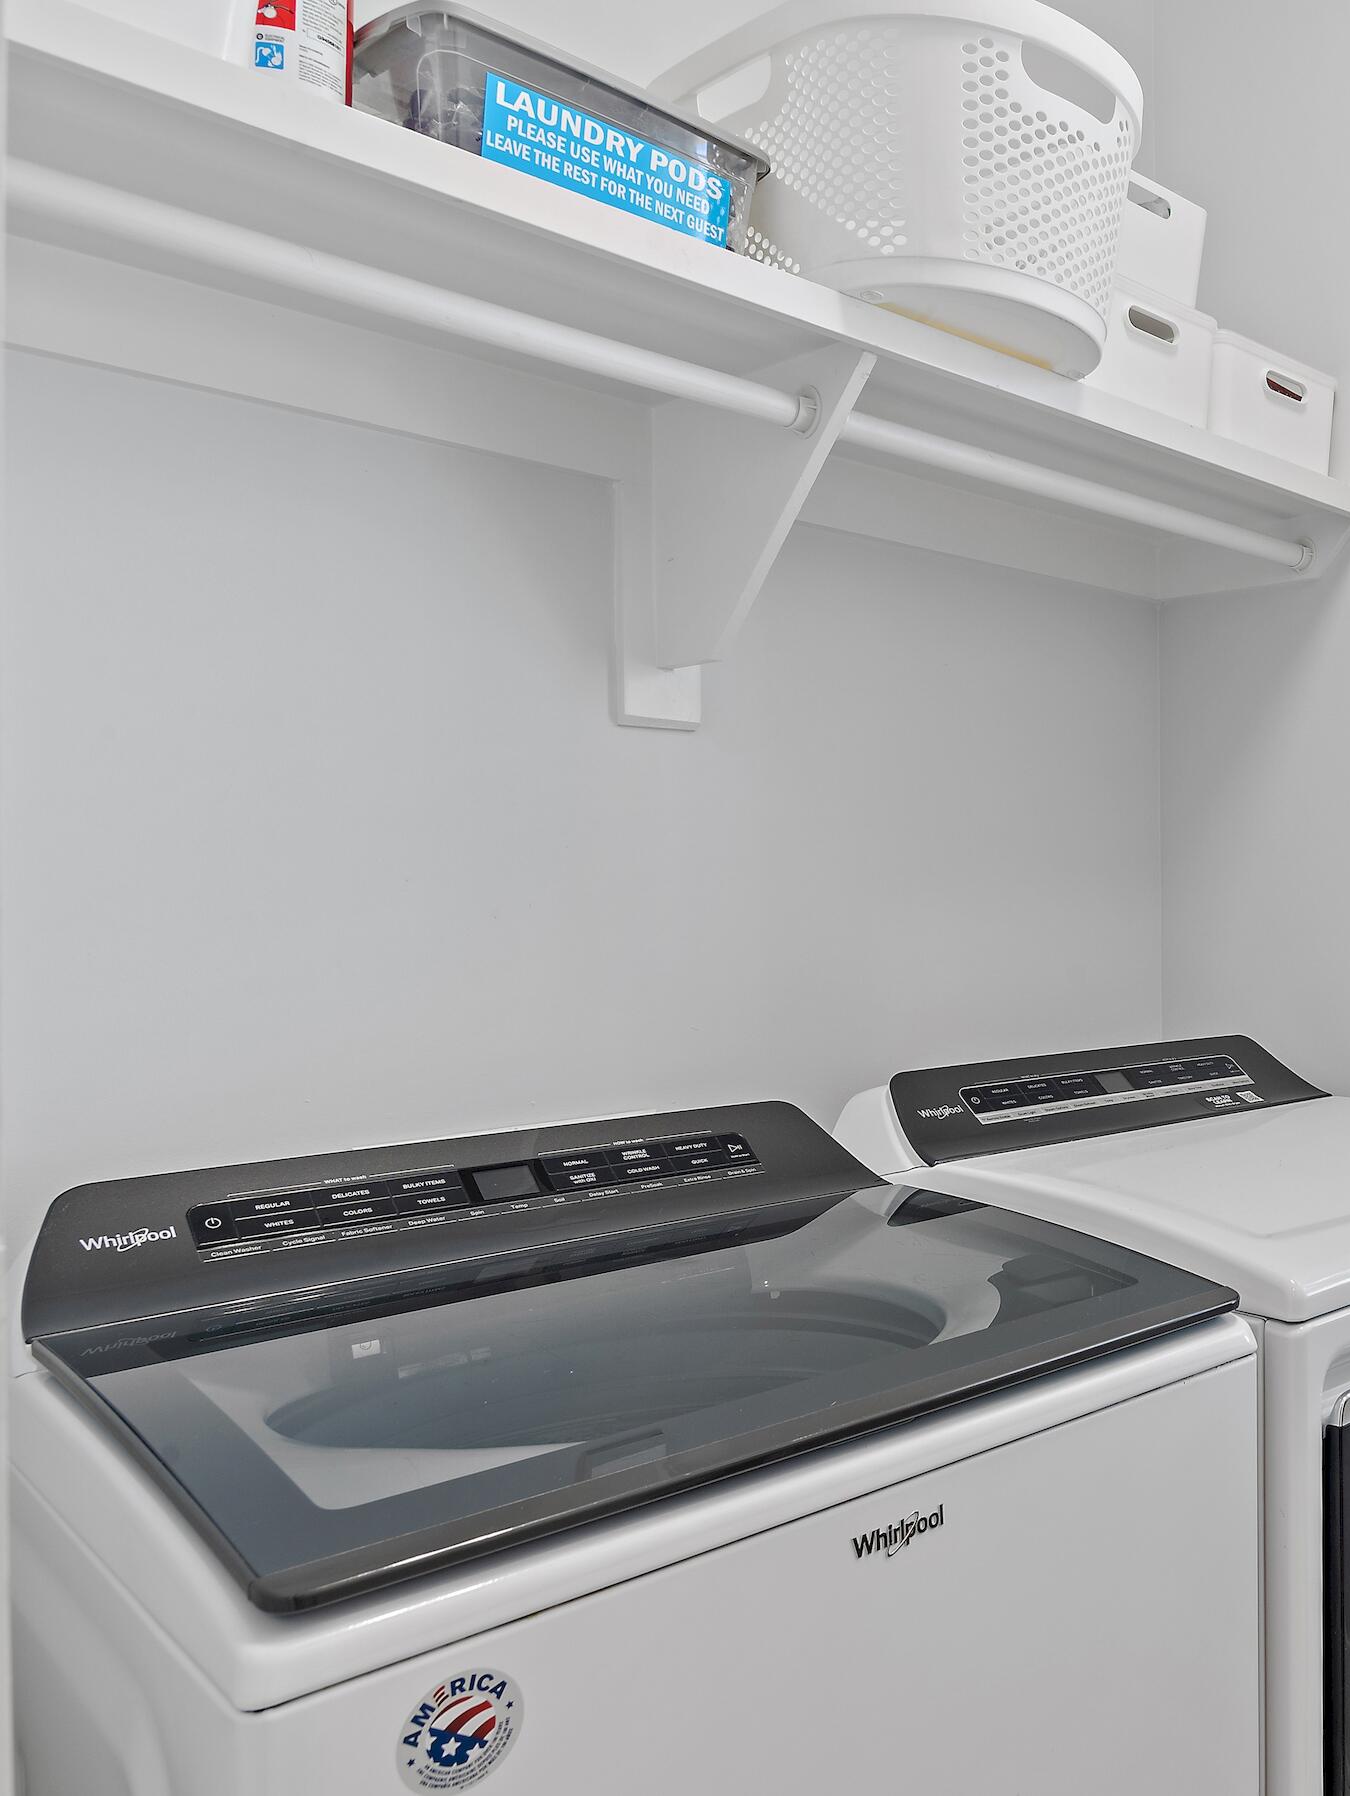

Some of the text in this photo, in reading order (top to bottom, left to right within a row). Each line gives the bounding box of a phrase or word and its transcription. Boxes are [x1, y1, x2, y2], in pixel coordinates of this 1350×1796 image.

[495, 80, 723, 200] LAUNDRY PODS
[507, 114, 711, 216] PLEASE USE WHAT YOU NEED
[486, 130, 724, 242] LEAVE THE REST FOR THE NEXT GUEST
[917, 1105, 965, 1120] Whirlpool
[621, 1148, 647, 1156] WRINKLE
[622, 1153, 650, 1161] CONTROL
[563, 1159, 589, 1167] NORMAL
[323, 1177, 343, 1185] WHAT
[569, 1172, 596, 1181] SANITIZE
[402, 1178, 446, 1190] BULKY ITEMS
[331, 1189, 370, 1200] DELICATES
[255, 1201, 291, 1211] REGULAR
[417, 1196, 446, 1205] TOWELS
[342, 1207, 373, 1217] COLORS
[470, 1209, 485, 1217] Spin
[264, 1219, 295, 1229] WHITES
[408, 1219, 427, 1227] Deep
[341, 1224, 393, 1237] Fabric Softener
[79, 1226, 177, 1252] Whirlpool
[282, 1234, 326, 1248] Cycle Signal
[210, 1244, 263, 1258] Clean Washer
[852, 1504, 944, 1558] Whirlpool
[403, 1674, 507, 1748] AMERICA
